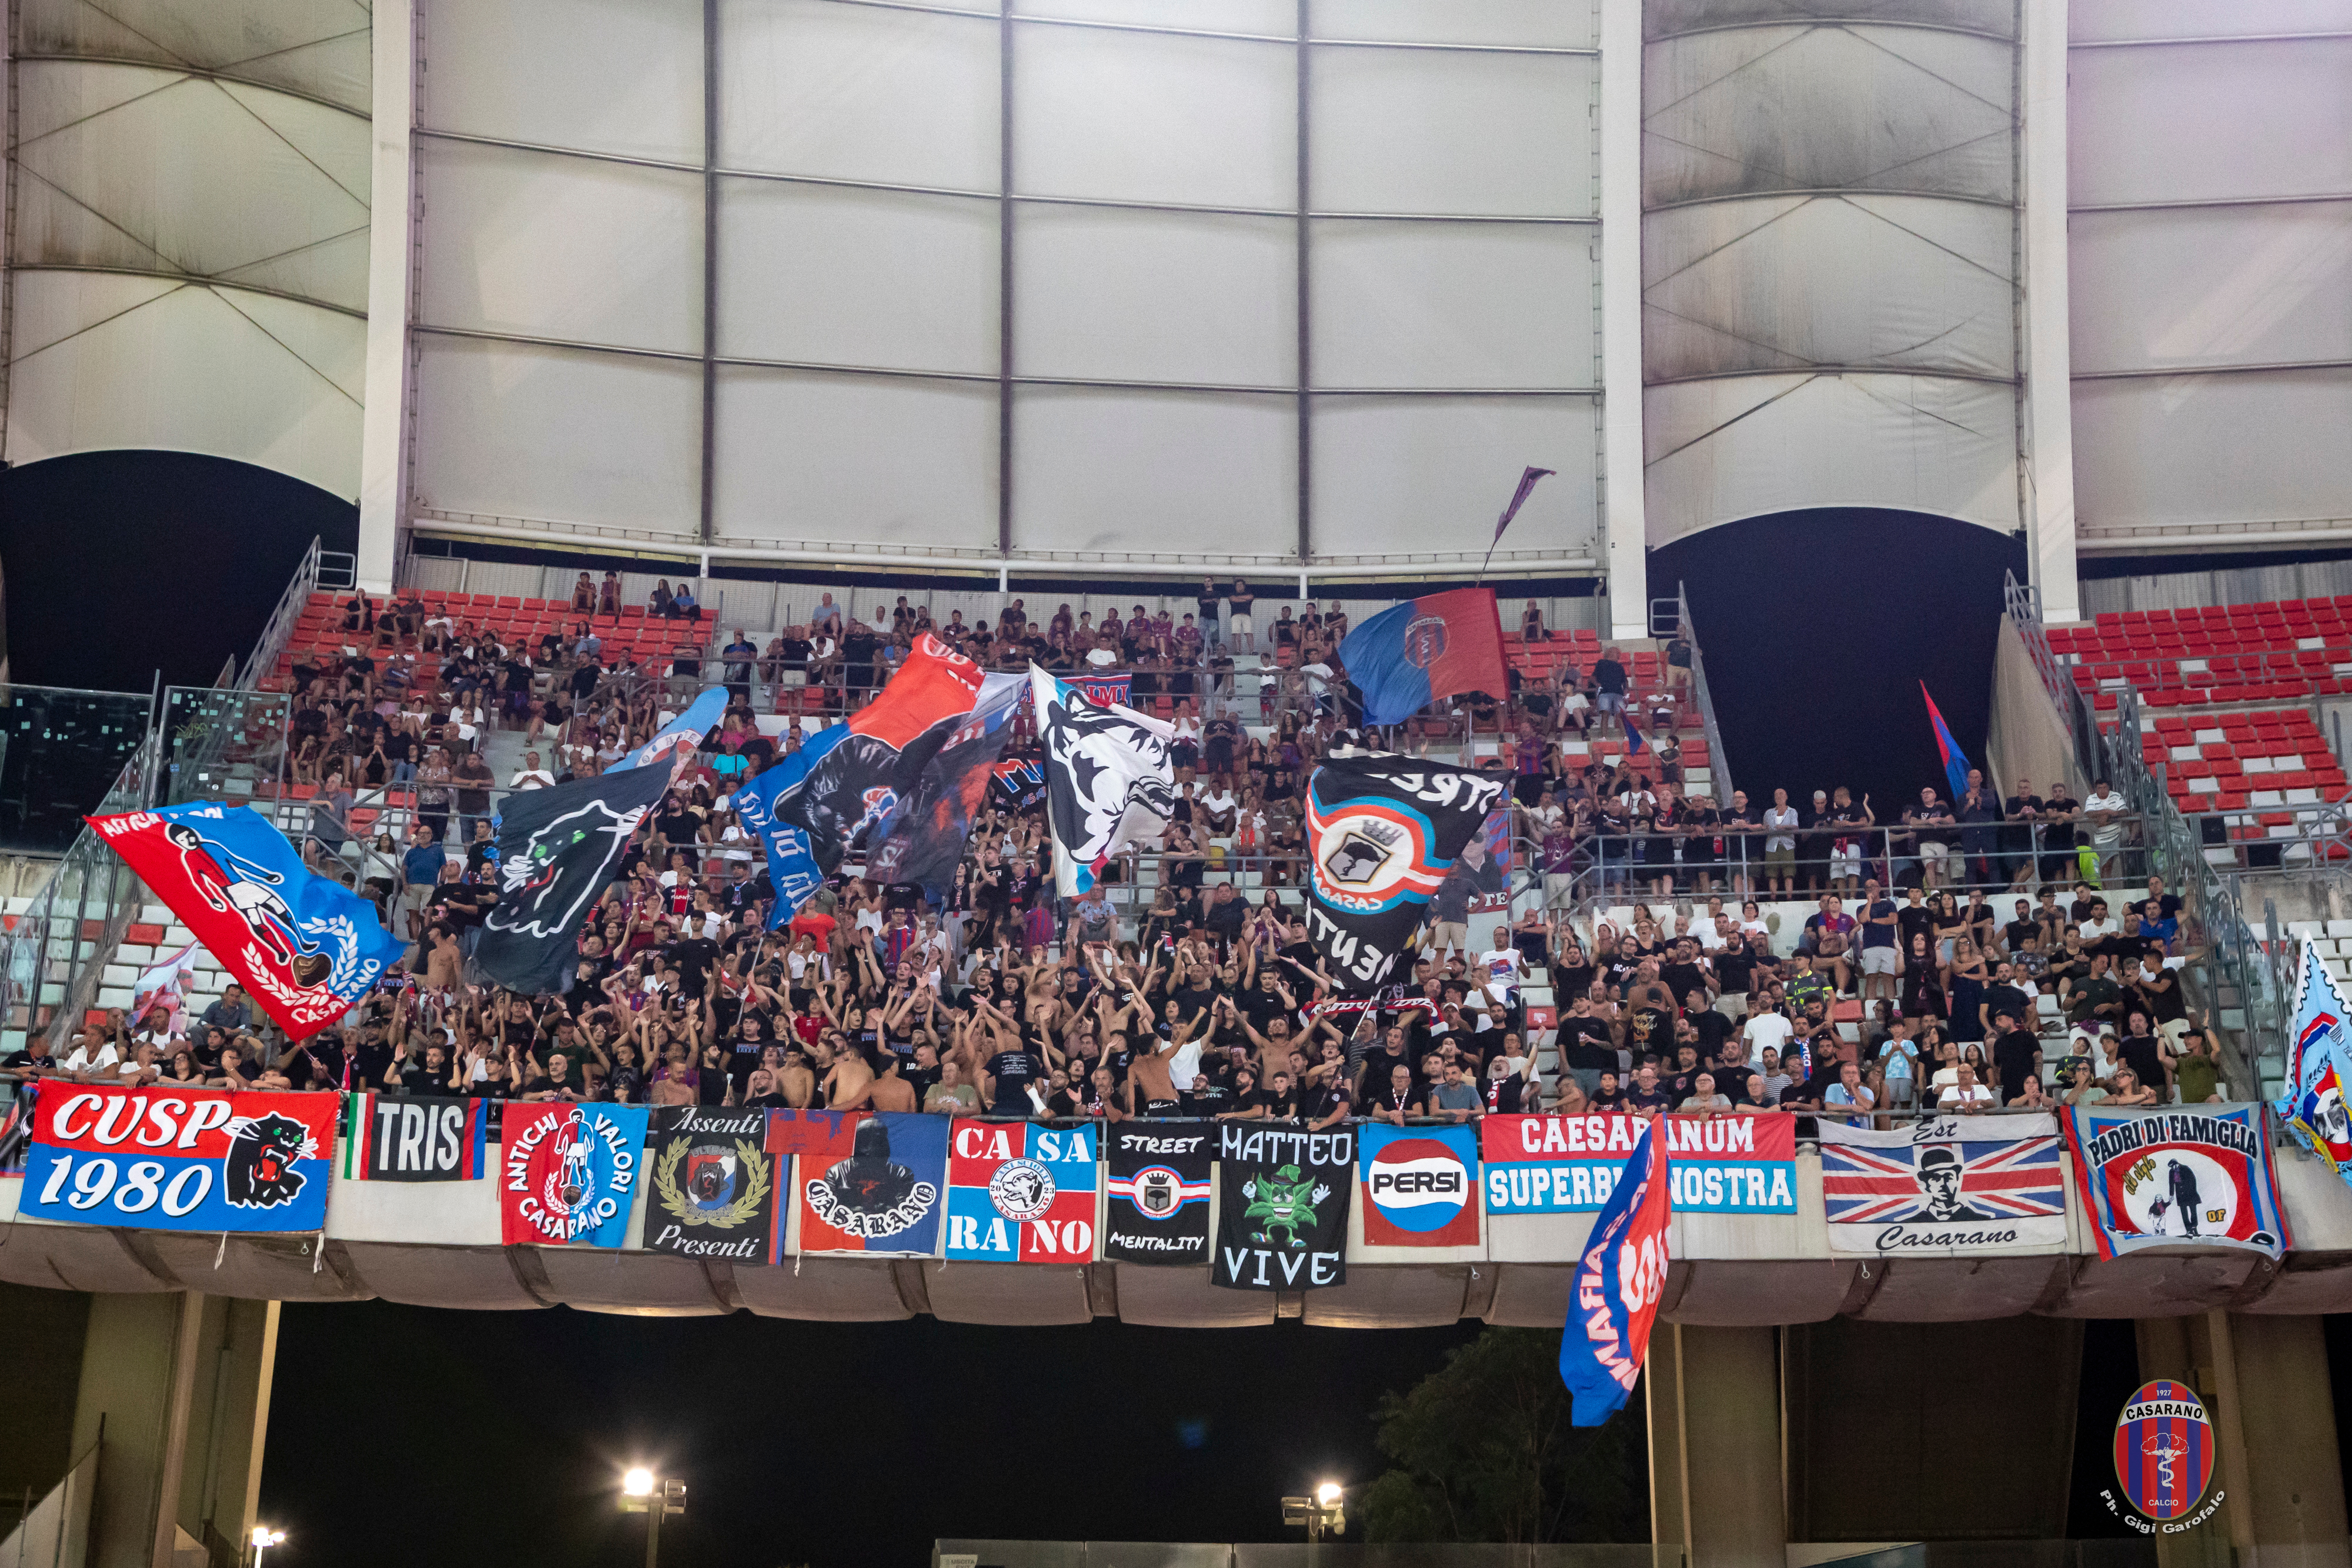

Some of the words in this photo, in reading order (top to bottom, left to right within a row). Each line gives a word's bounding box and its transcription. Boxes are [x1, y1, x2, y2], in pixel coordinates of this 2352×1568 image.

[291, 958, 382, 1025] CASARANO
[54, 1094, 233, 1149] CUSP
[377, 1102, 464, 1171] TRIS
[670, 1107, 764, 1135] Assenti
[1912, 1118, 1958, 1142] Est
[508, 1111, 559, 1192] ANTICHI
[594, 1112, 634, 1193] VALORI
[690, 1145, 737, 1158] ULTRAS
[956, 1127, 1013, 1160] CA
[1037, 1132, 1092, 1163] SA
[1121, 1134, 1205, 1154] STREET
[1222, 1125, 1352, 1165] MATTEO
[2089, 1122, 2141, 1166] PADRI
[2144, 1118, 2166, 1143] DI
[2170, 1115, 2258, 1159] FAMIGLIA
[39, 1154, 213, 1217] 1980
[994, 1162, 1015, 1182] CANI
[1017, 1160, 1051, 1185] SCIOLTI
[1373, 1171, 1461, 1195] PERSI
[519, 1196, 617, 1239] CASARANO
[807, 1179, 936, 1237] CASARANO
[994, 1195, 1050, 1219] CASARANO
[2206, 1208, 2226, 1223] OF
[654, 1224, 760, 1258] Presenti
[948, 1215, 1011, 1252] RA
[1029, 1220, 1093, 1254] NO
[1110, 1231, 1205, 1251] MENTALITY
[1875, 1225, 2019, 1251] Casarano
[1224, 1246, 1339, 1286] VIVE
